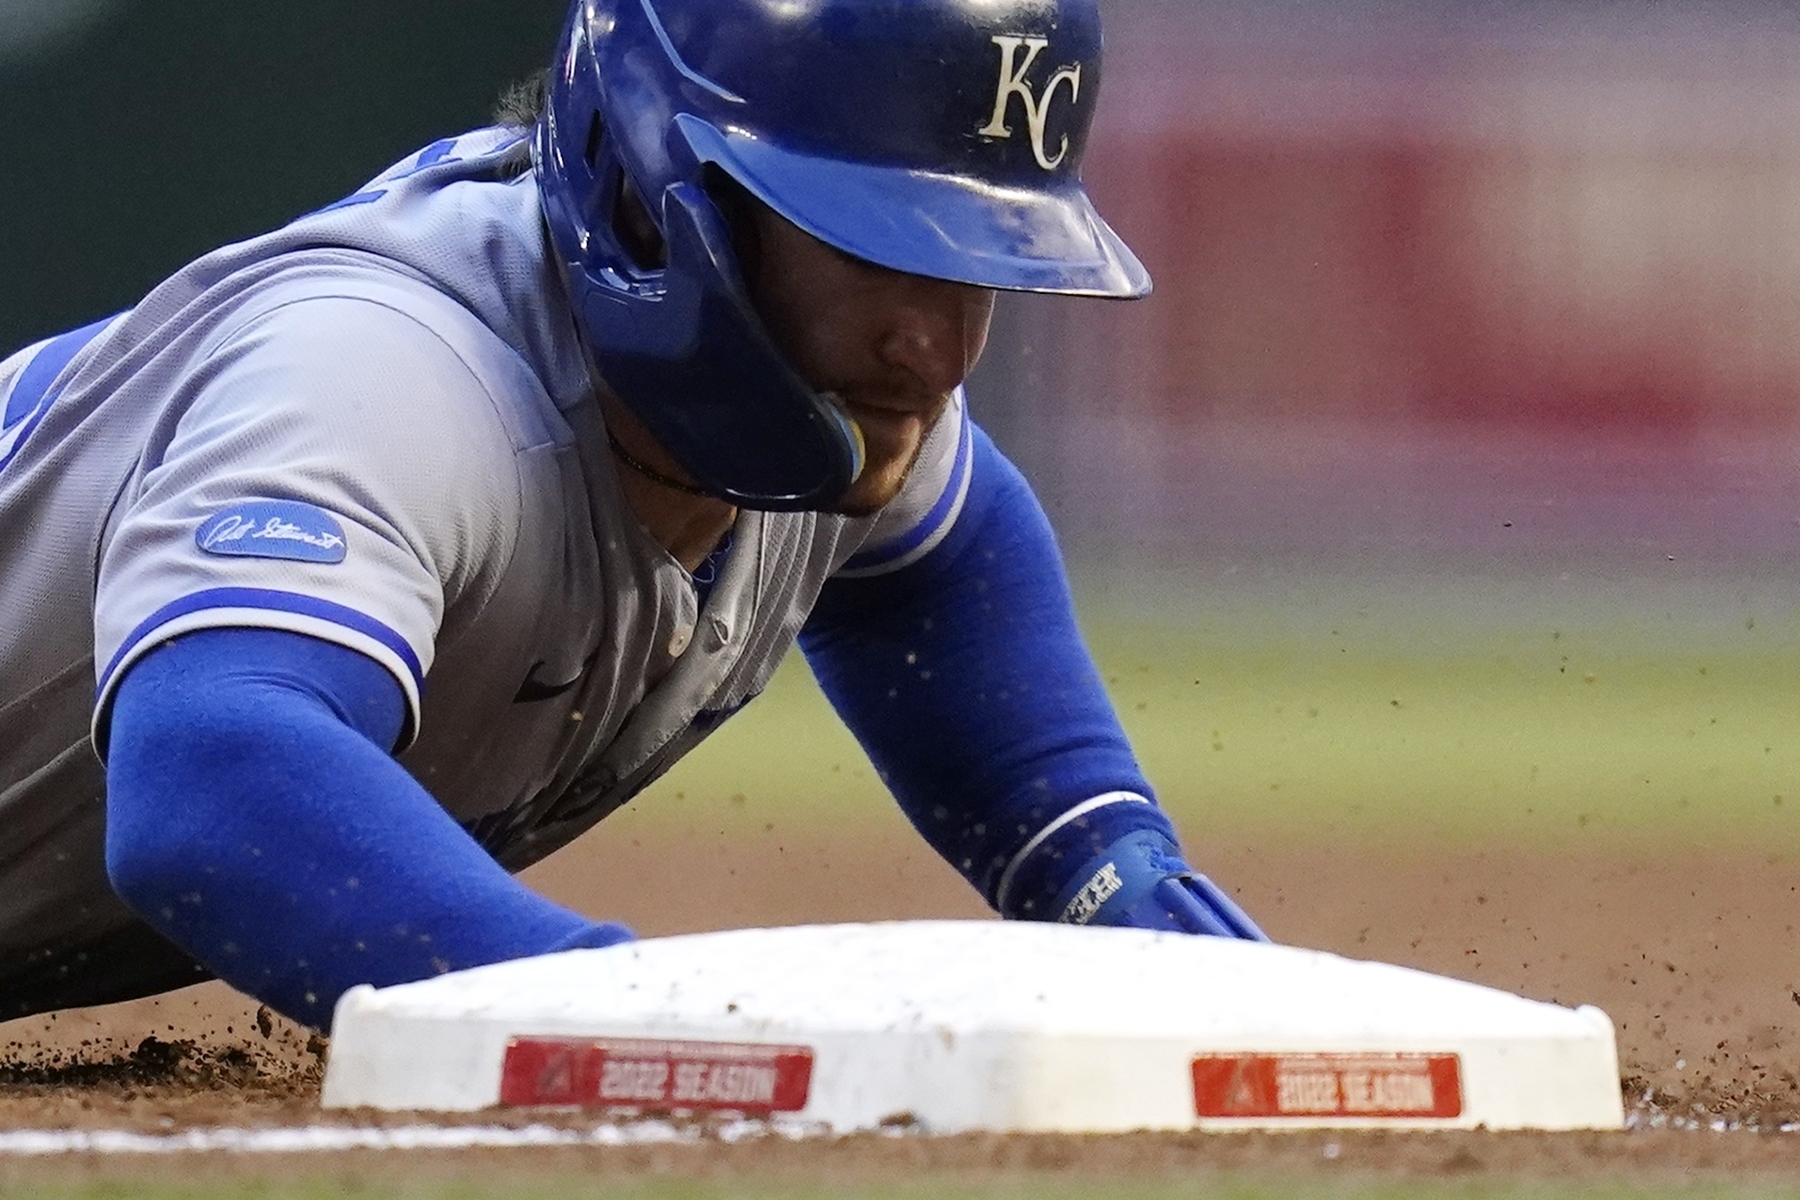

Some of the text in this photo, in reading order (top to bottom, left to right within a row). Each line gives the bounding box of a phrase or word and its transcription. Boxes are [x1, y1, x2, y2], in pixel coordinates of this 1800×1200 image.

[977, 33, 1082, 171] KC
[599, 1061, 669, 1100] 2022
[671, 1063, 778, 1103] SEASON
[1276, 1072, 1339, 1114] 2022
[1341, 1072, 1435, 1113] SEASON
